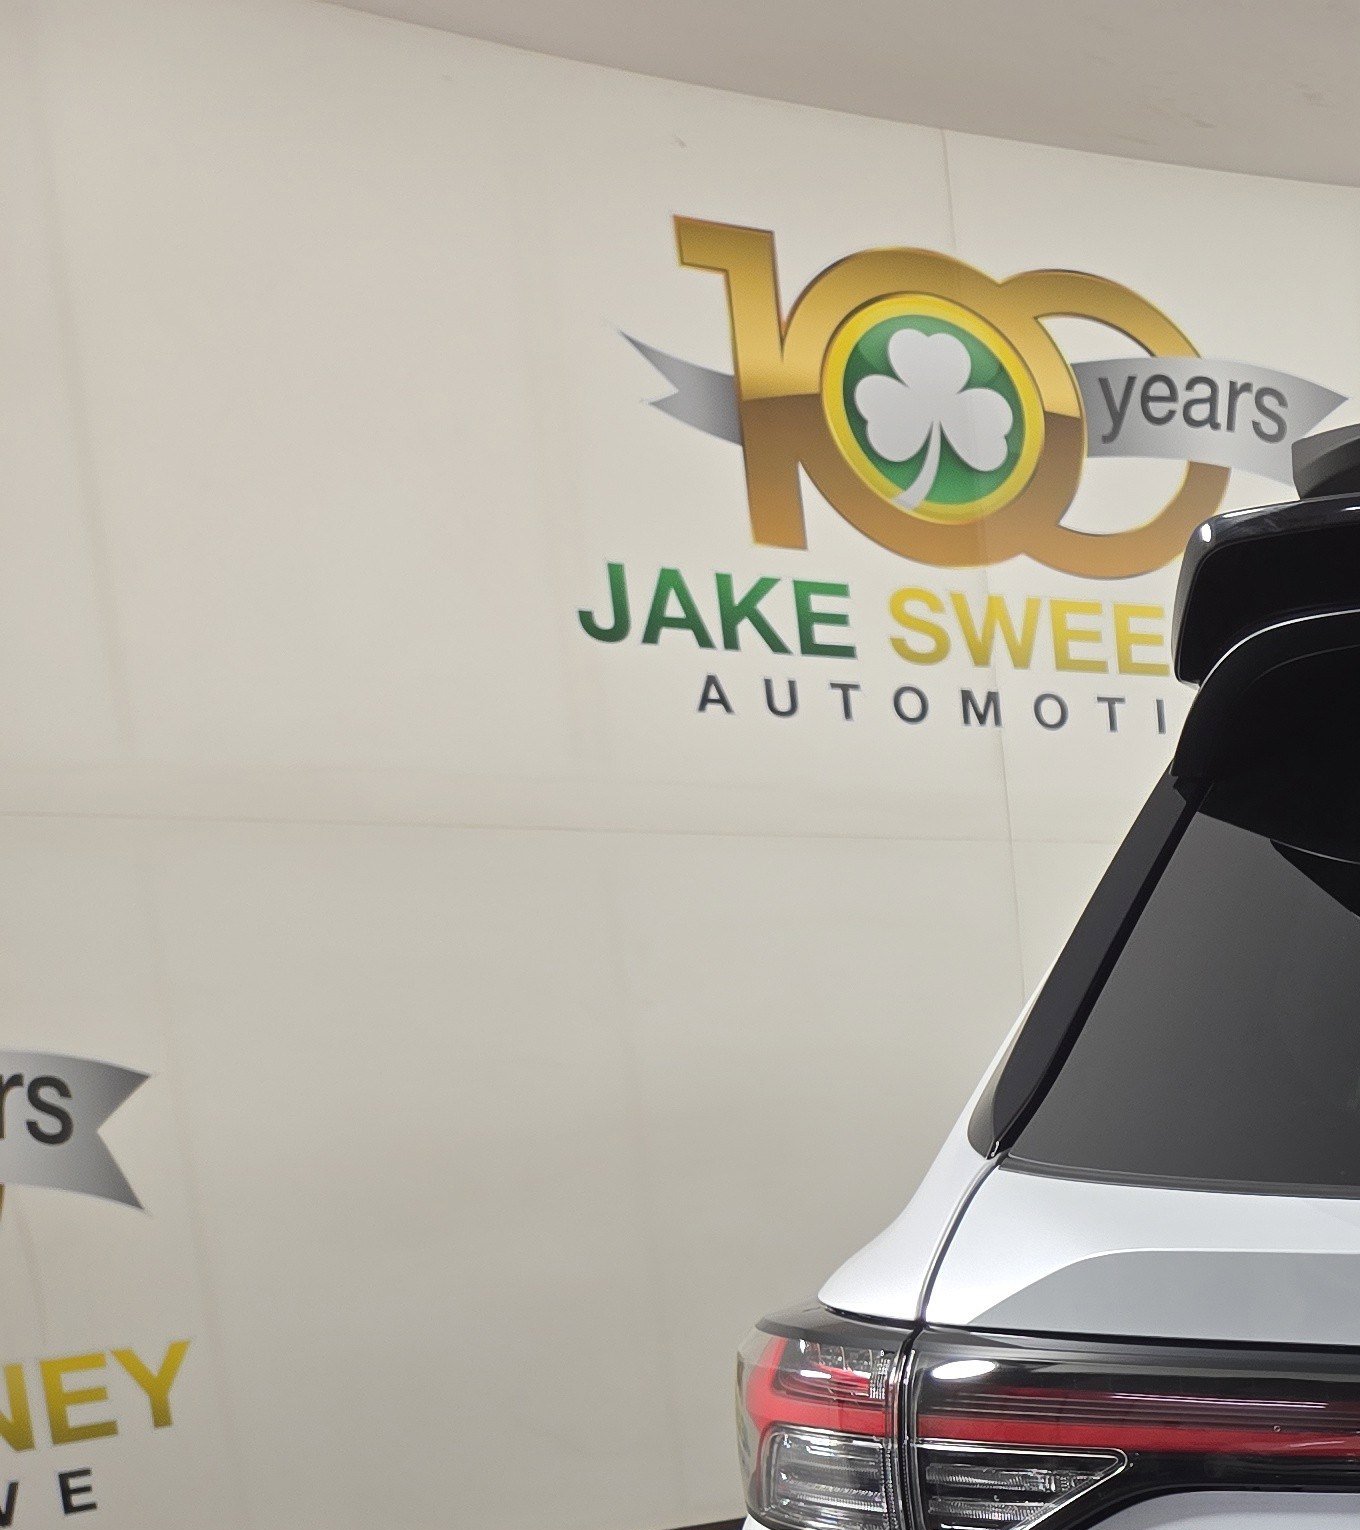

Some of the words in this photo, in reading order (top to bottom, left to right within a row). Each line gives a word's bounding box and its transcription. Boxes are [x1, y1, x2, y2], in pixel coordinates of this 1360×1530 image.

[1098, 372, 1289, 444] years
[577, 562, 858, 659] JAKE
[889, 586, 1171, 677] SWEE
[697, 674, 1167, 735] AUTOMOTI
